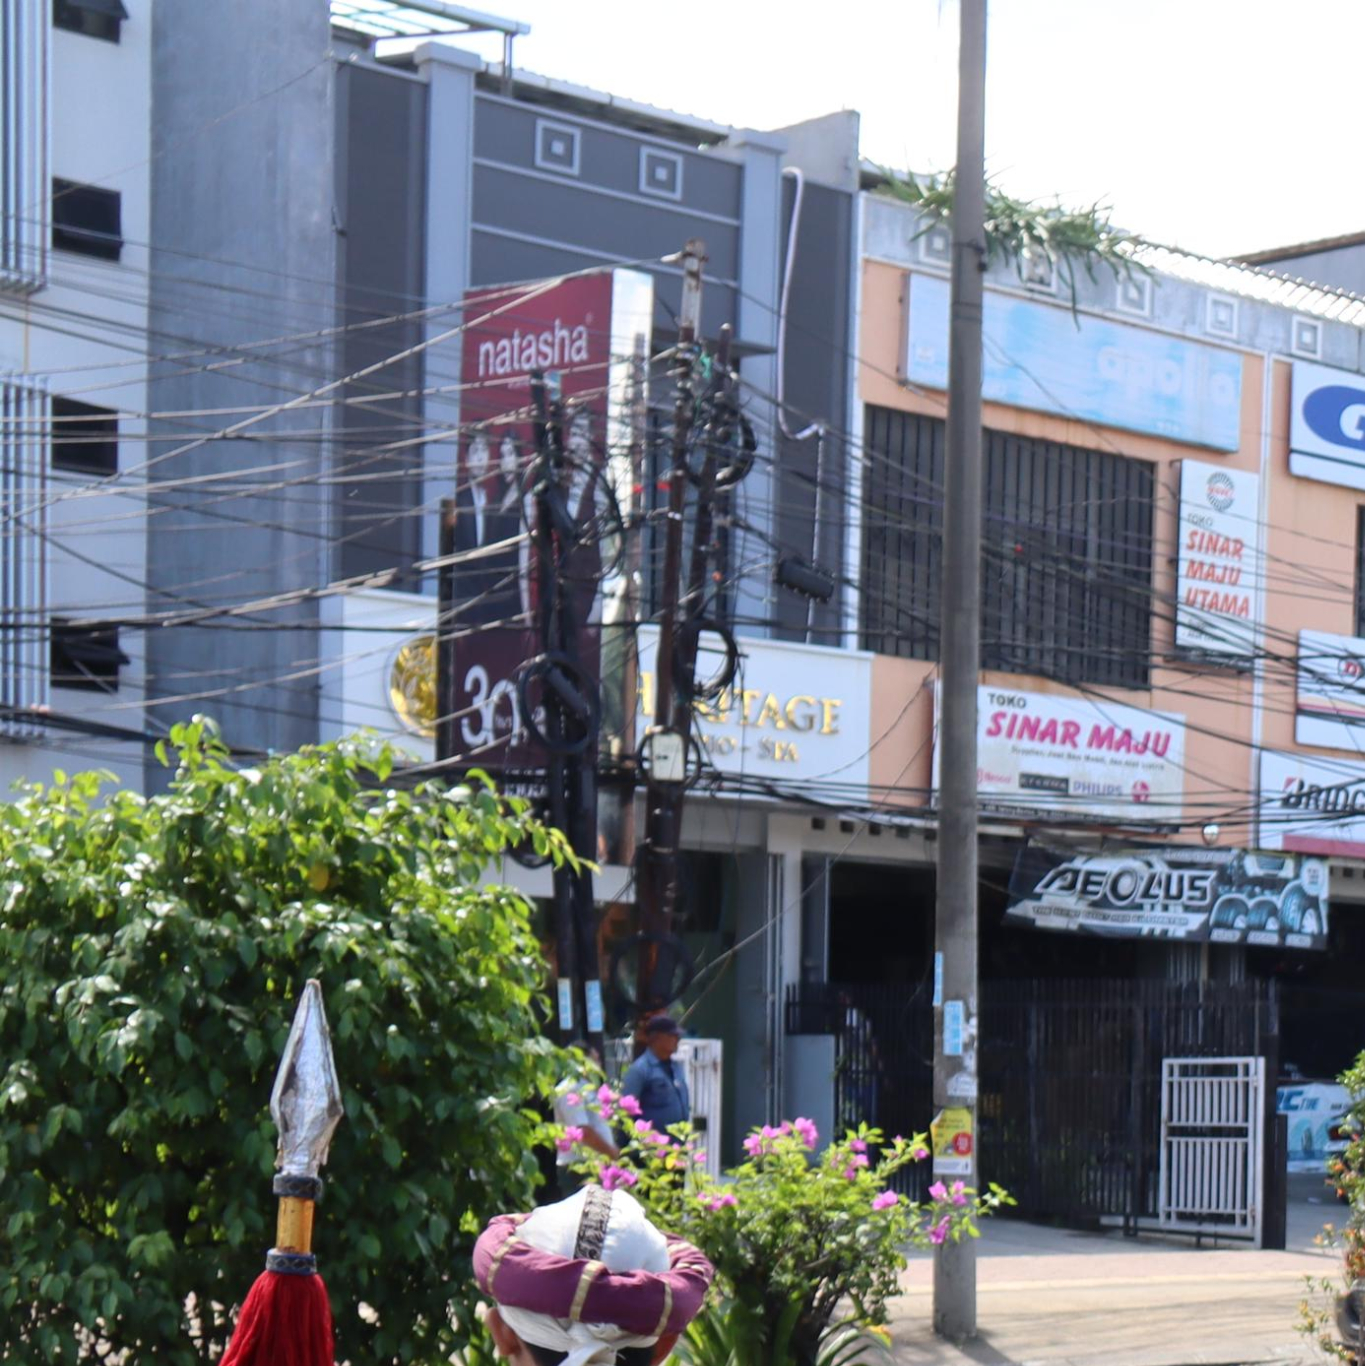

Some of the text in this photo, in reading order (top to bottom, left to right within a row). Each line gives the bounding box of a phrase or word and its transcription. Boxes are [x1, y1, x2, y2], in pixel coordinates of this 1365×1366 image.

[478, 318, 589, 377] natasha
[1186, 530, 1244, 561] SINAR
[1185, 559, 1241, 587] MAJU
[1185, 586, 1249, 619] UTAMA
[987, 692, 1028, 710] TOKO
[985, 711, 1172, 757] SINAR MAJU
[1073, 780, 1124, 797] PHILIPS
[1034, 863, 1217, 905] AEOLUS
